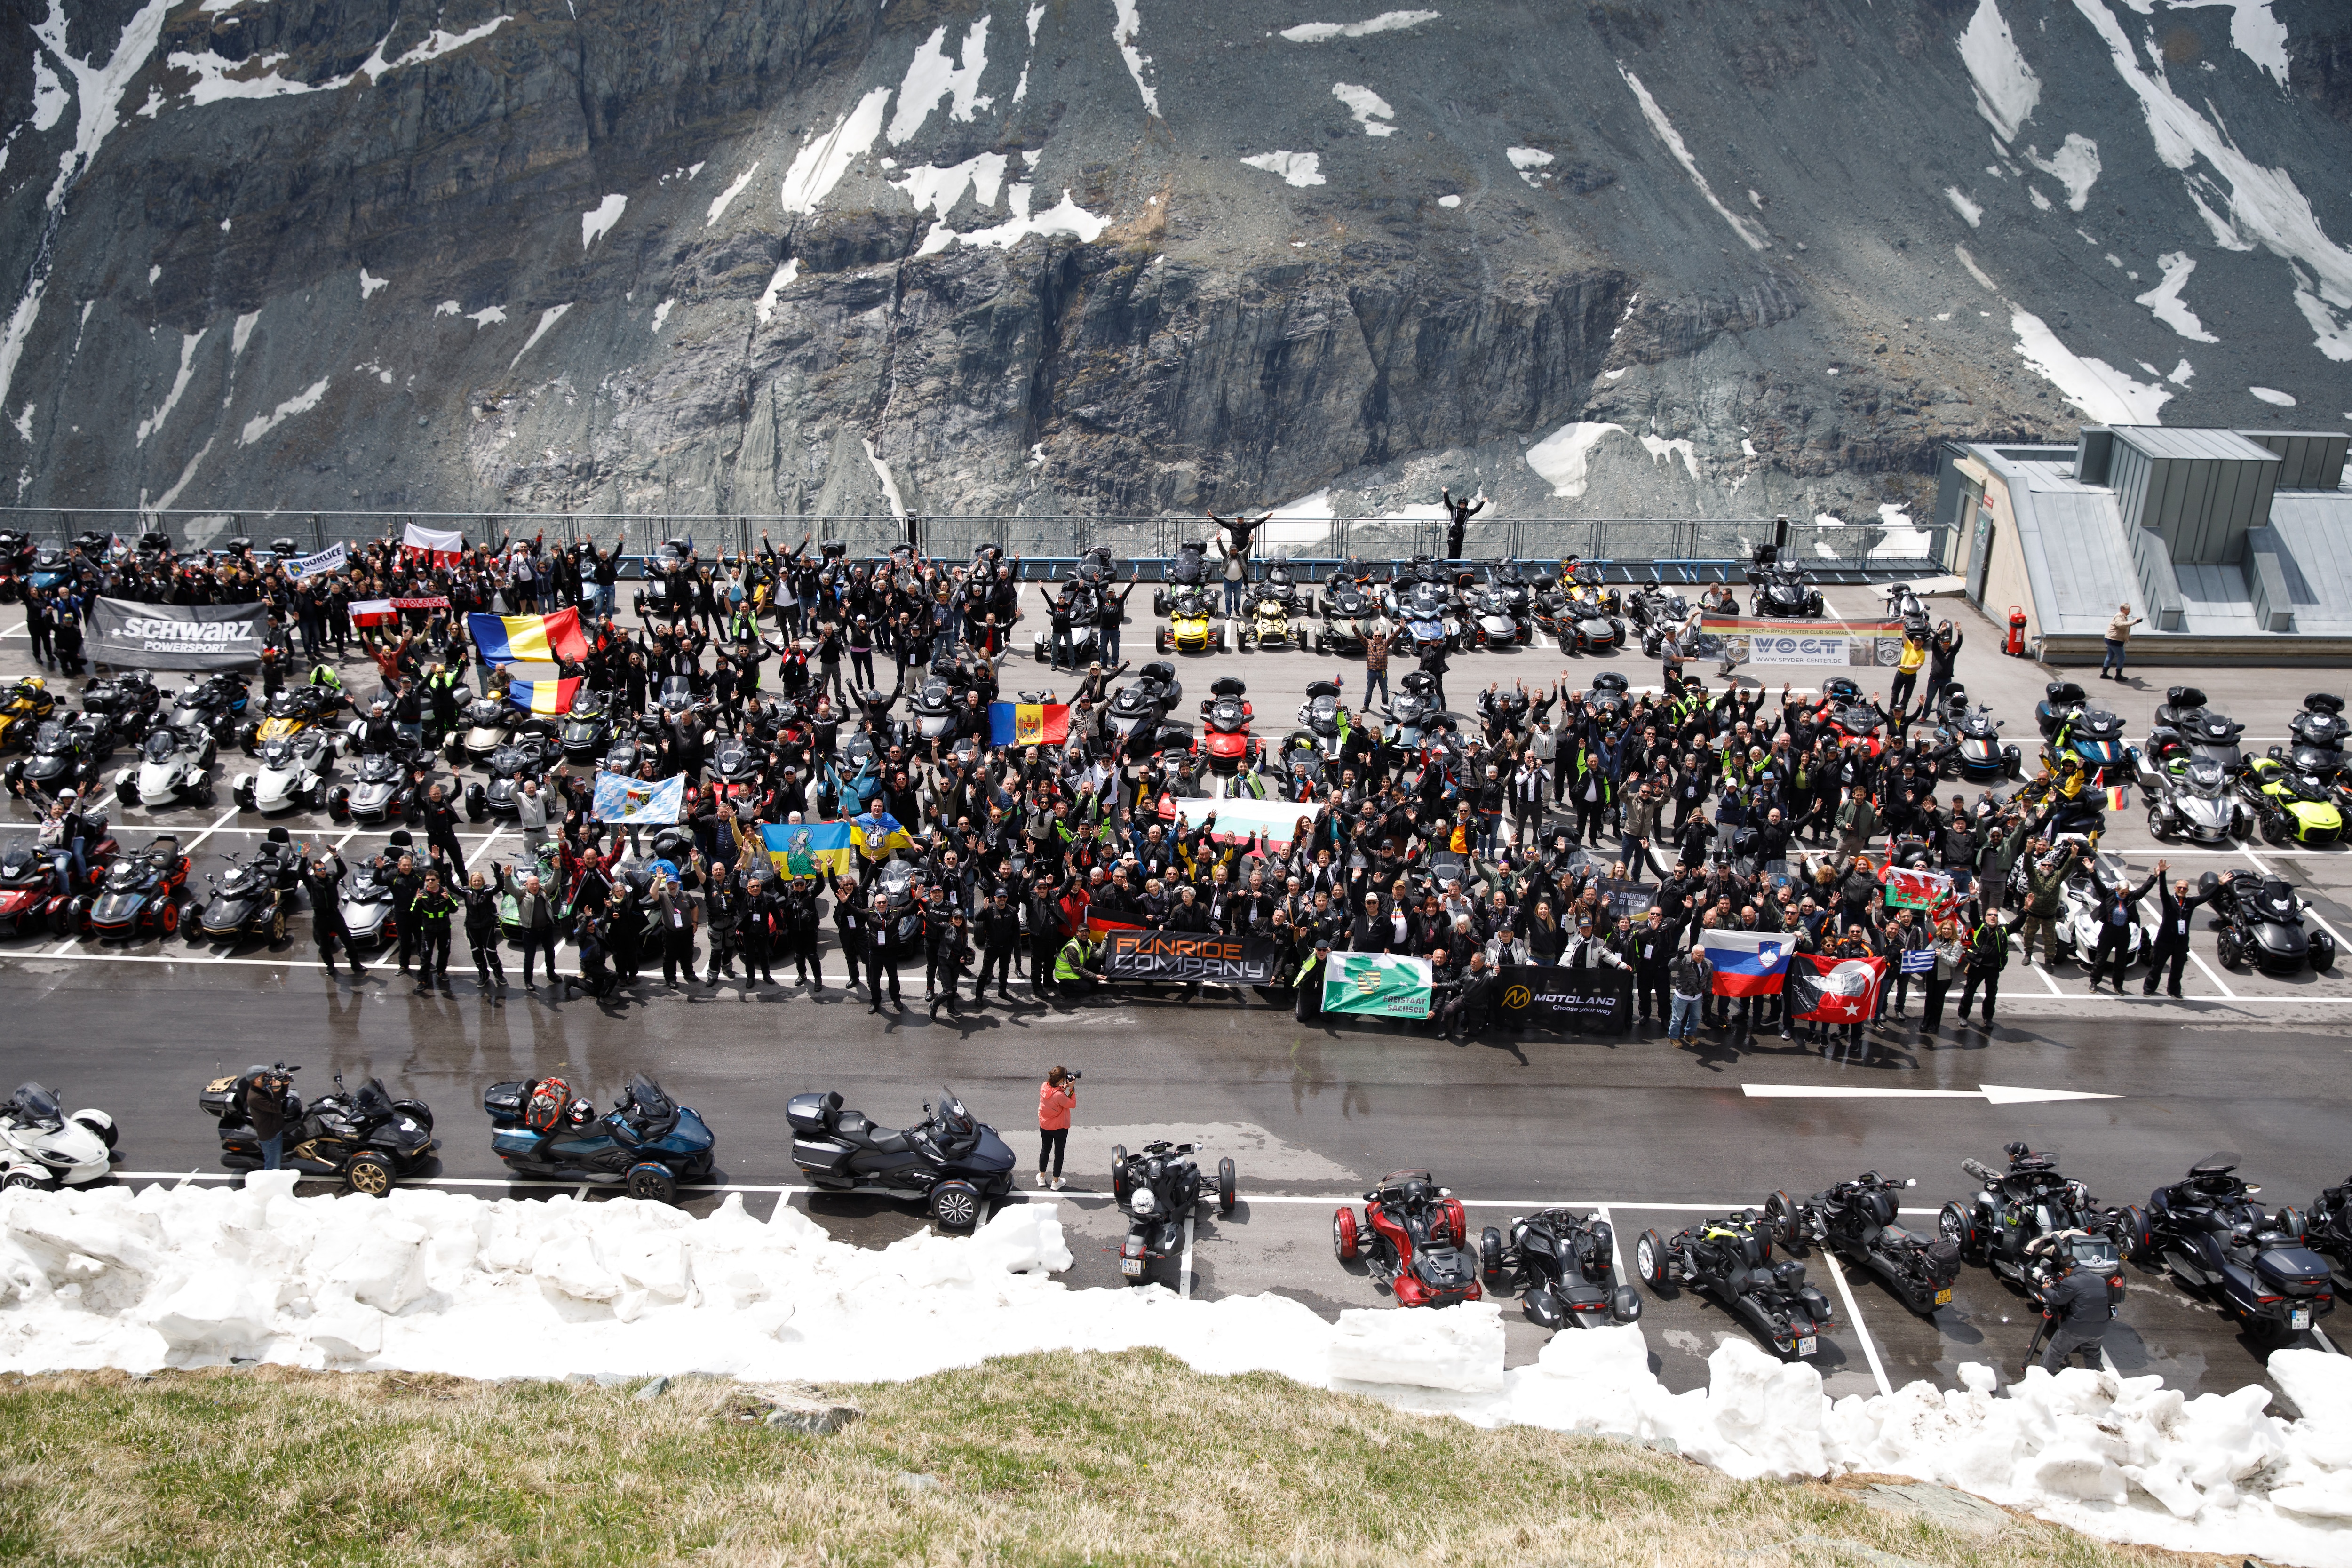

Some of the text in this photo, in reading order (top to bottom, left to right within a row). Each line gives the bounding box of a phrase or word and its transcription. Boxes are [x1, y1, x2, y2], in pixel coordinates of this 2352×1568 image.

[302, 547, 342, 567] GORLICE
[402, 599, 444, 608] POLSKA
[143, 641, 227, 653] POWERSPORT
[1754, 637, 1843, 654] VOGT
[1619, 892, 1648, 901] ADVENTURE
[1116, 937, 1243, 960] FUNRIDE
[1114, 954, 1264, 978] COMPANY
[1383, 995, 1426, 1005] FREISTAAT
[1534, 993, 1616, 1007] MOTOLAND
[1579, 1006, 1595, 1015] your
